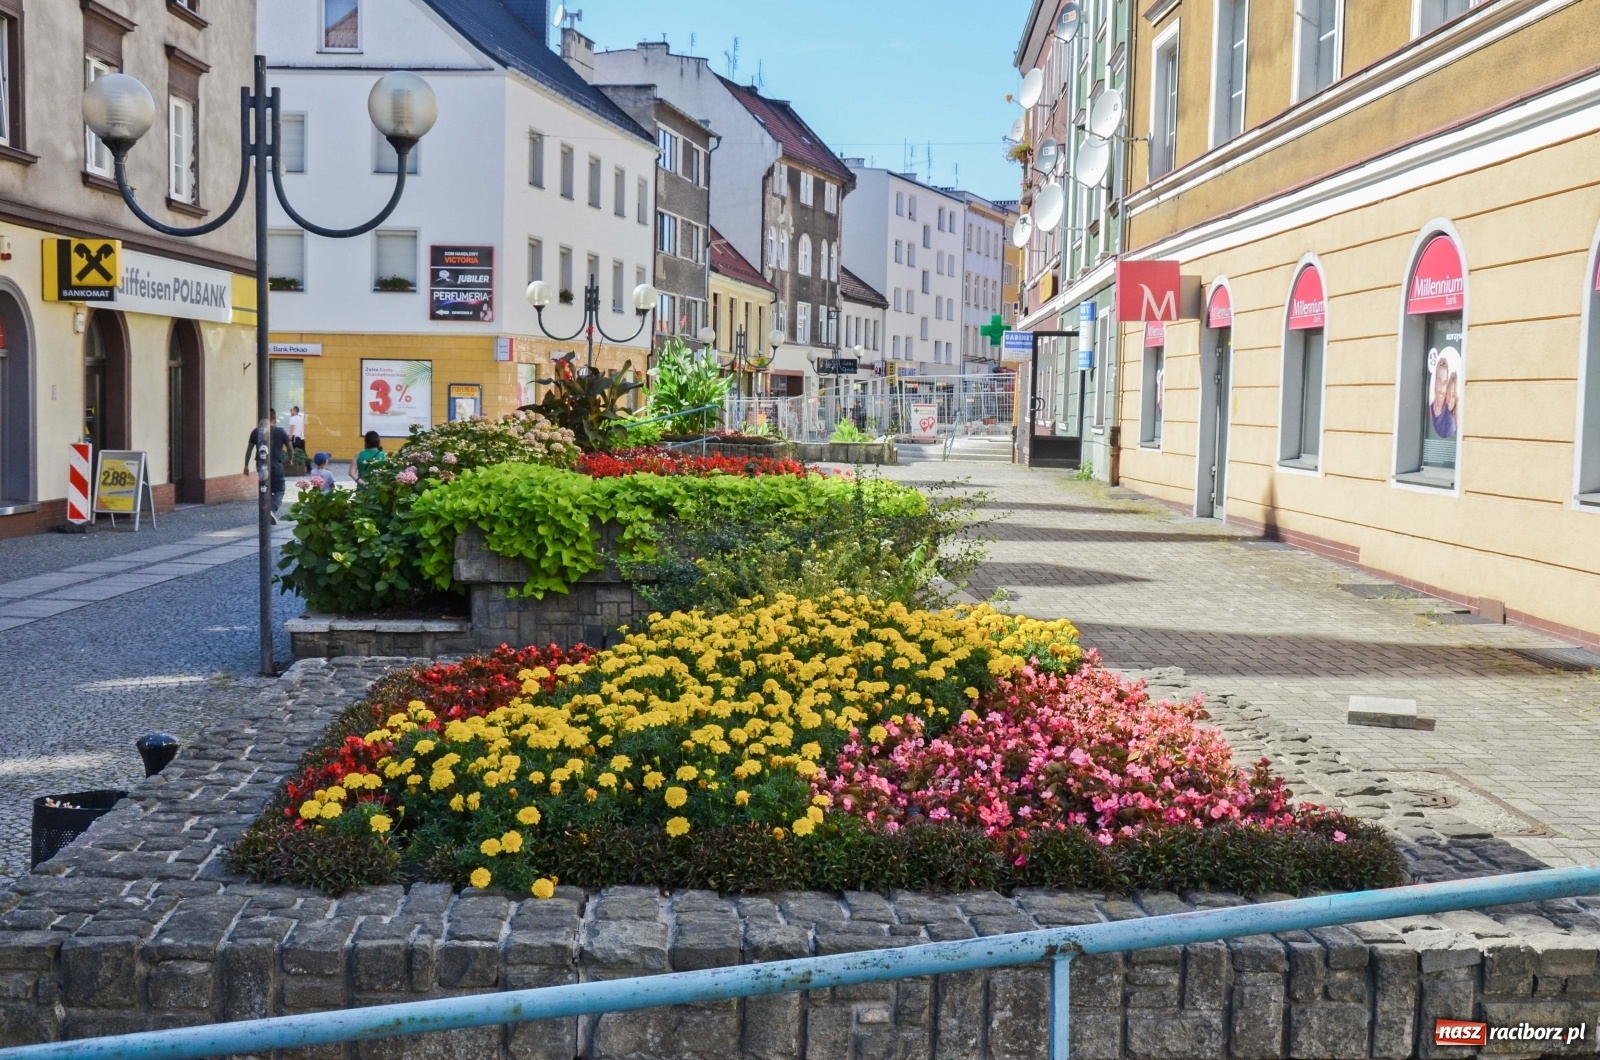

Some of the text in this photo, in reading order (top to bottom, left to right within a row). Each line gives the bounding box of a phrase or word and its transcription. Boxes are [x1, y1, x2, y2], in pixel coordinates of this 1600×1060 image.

[444, 256, 479, 264] VICTORIA
[457, 274, 490, 285] JUBILER
[1415, 275, 1463, 298] Millennium
[62, 289, 110, 298] BANKOMAT
[173, 277, 226, 309] POLBANK
[433, 291, 489, 301] PERFUMERIA
[1293, 298, 1325, 316] Millennium
